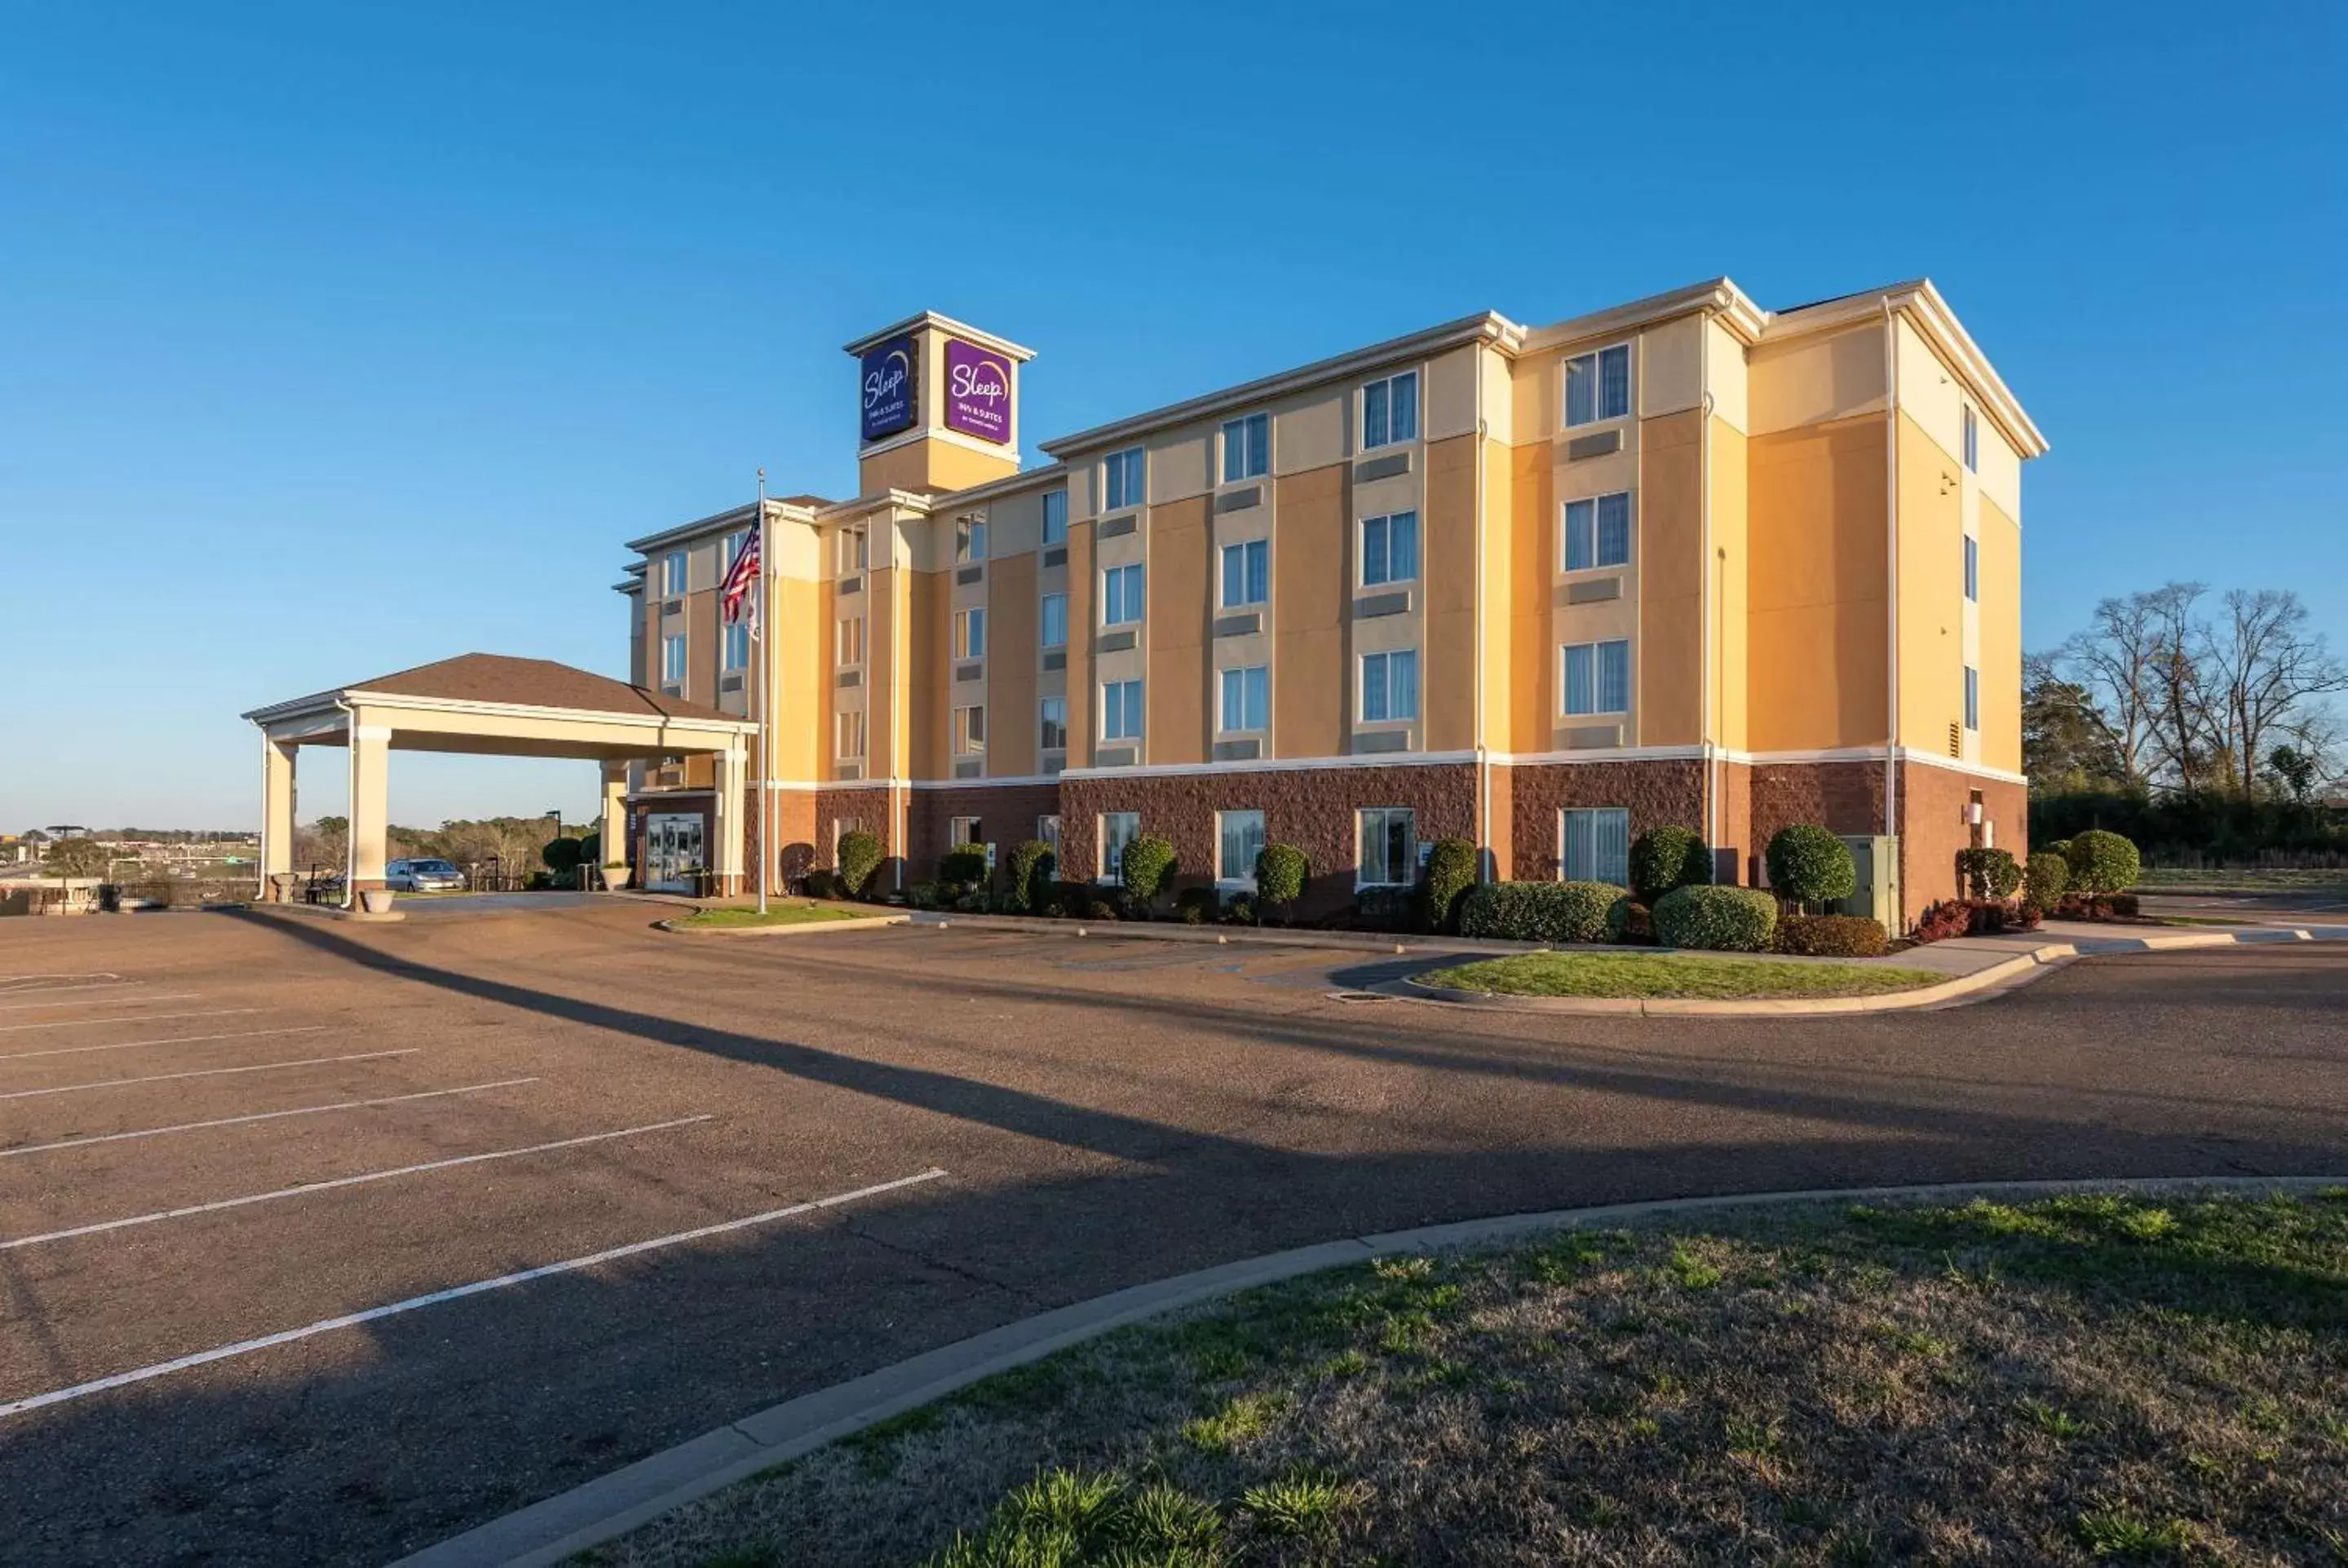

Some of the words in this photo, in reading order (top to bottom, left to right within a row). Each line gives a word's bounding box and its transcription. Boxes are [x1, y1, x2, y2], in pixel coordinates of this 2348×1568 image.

[865, 366, 904, 409] Sleep
[952, 364, 1003, 407] Sleep
[979, 409, 1003, 423] SUITES
